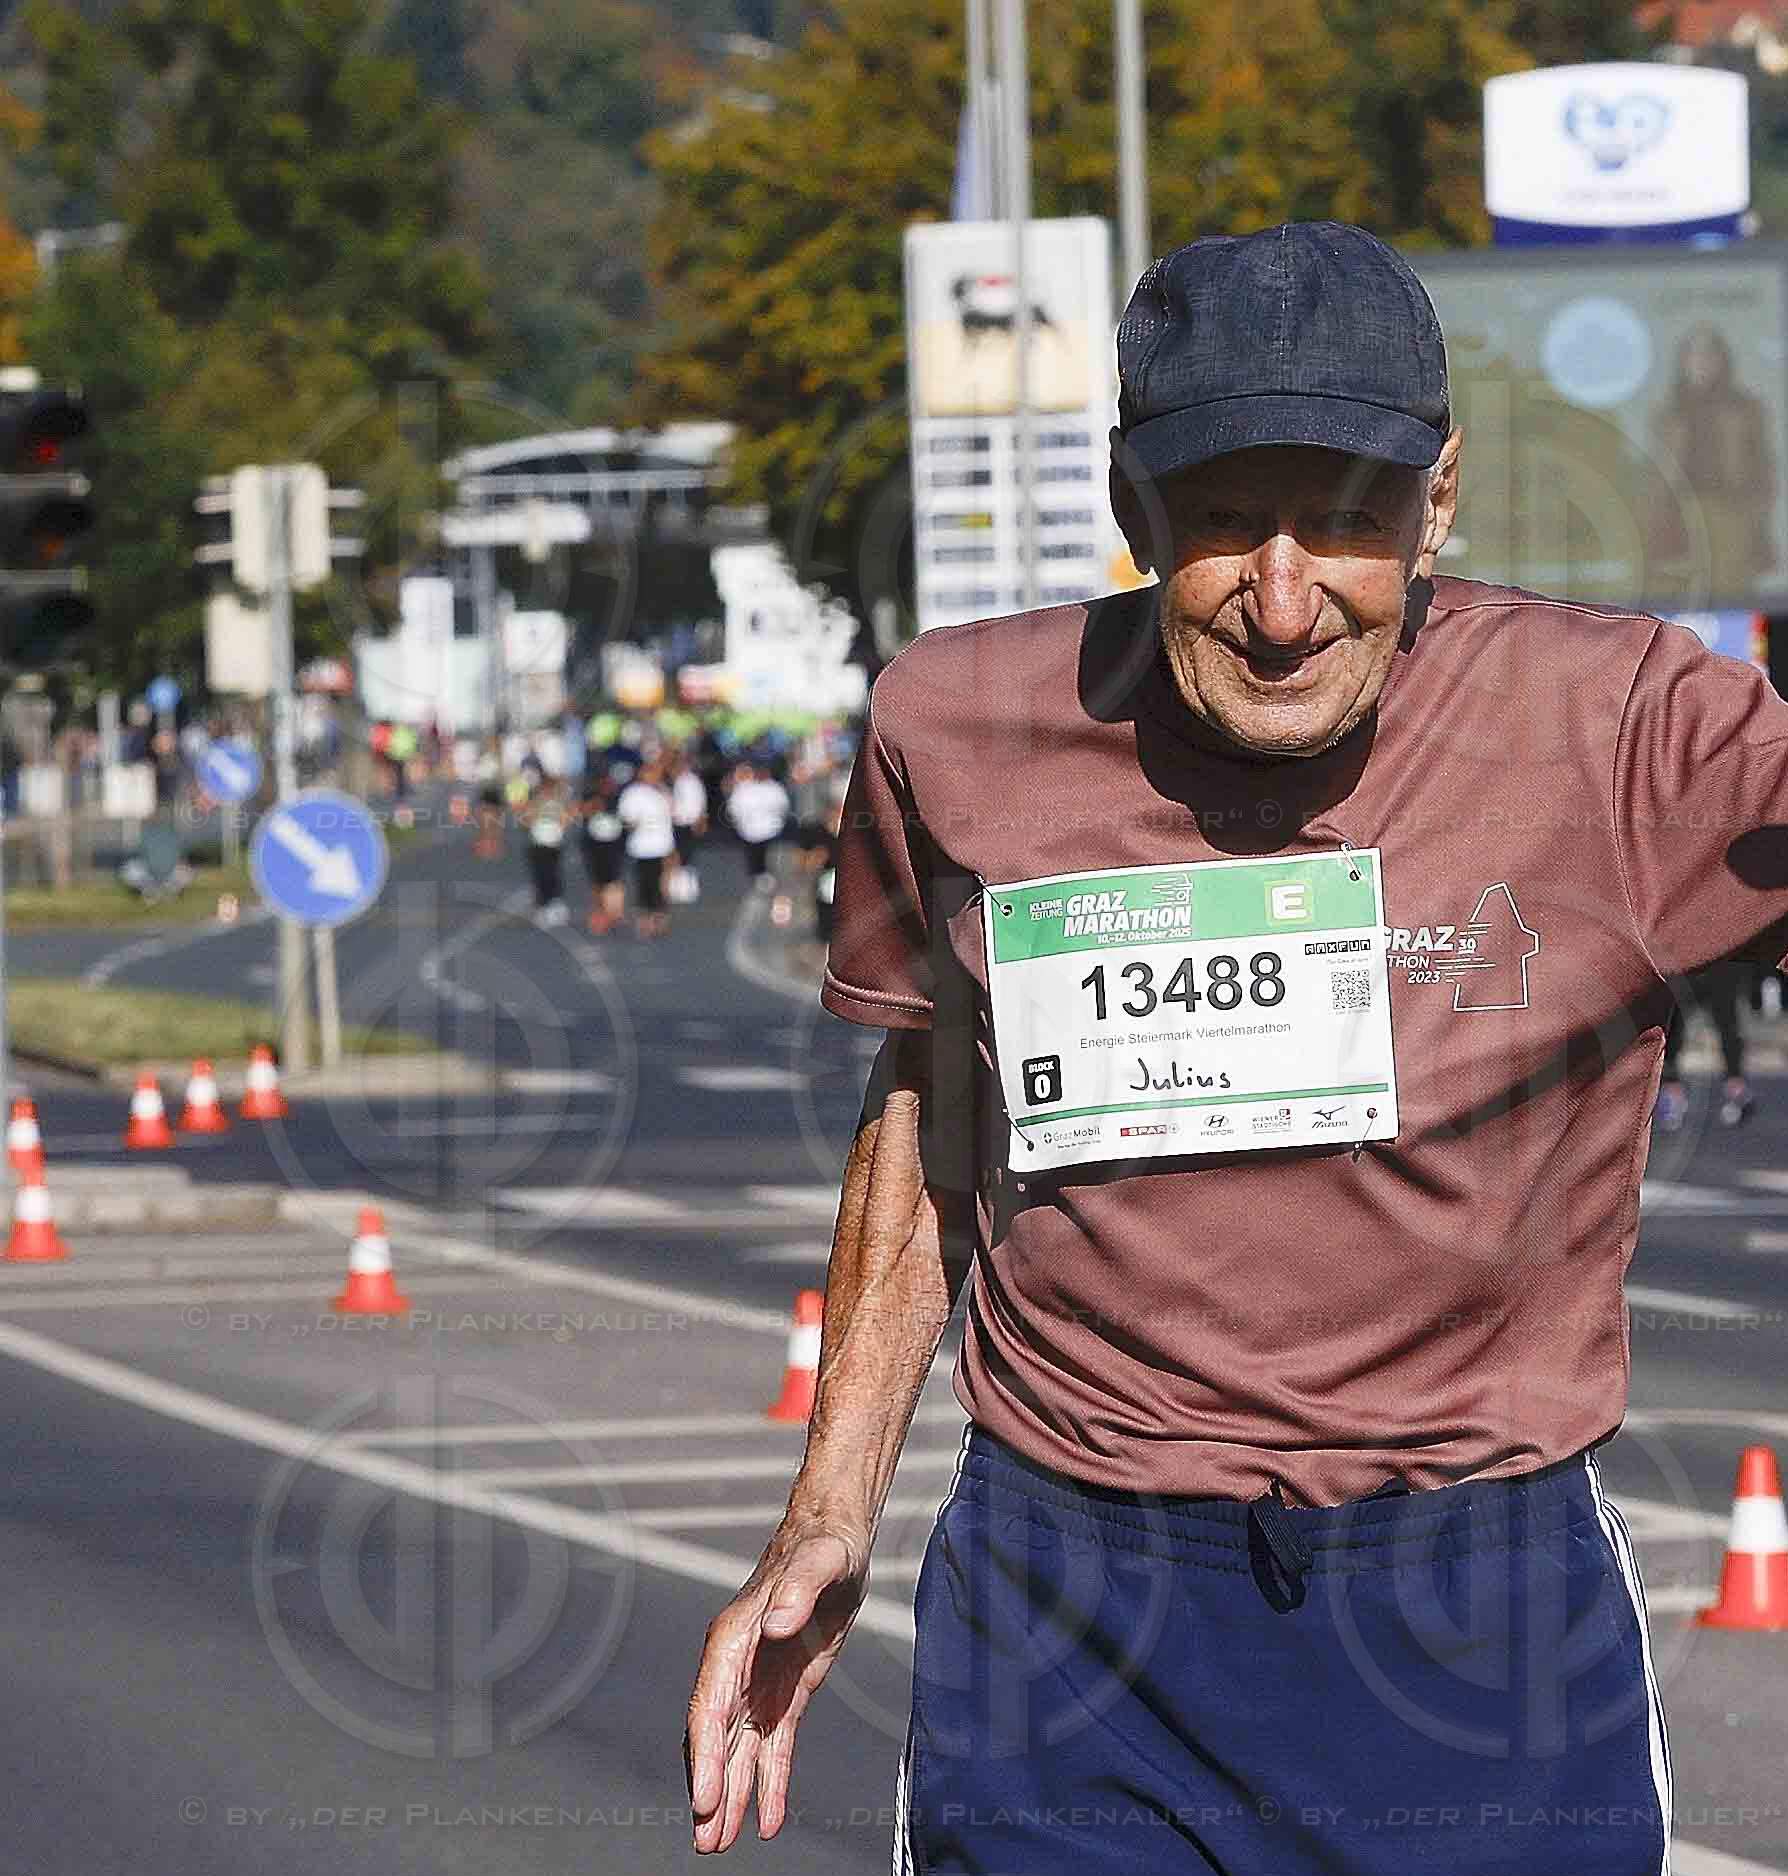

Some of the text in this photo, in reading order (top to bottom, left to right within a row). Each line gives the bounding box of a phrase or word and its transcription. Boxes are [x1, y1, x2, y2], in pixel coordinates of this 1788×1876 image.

[1066, 889, 1128, 917] GRAZ
[1063, 905, 1192, 938] MARATHON
[1081, 951, 1285, 1020] 13488
[1408, 971, 1441, 984] 2023
[1080, 1021, 1291, 1050] Energie Steiermark Viertelmarathon
[1028, 1060, 1055, 1073] BLOCK
[1130, 1057, 1231, 1091] Julius
